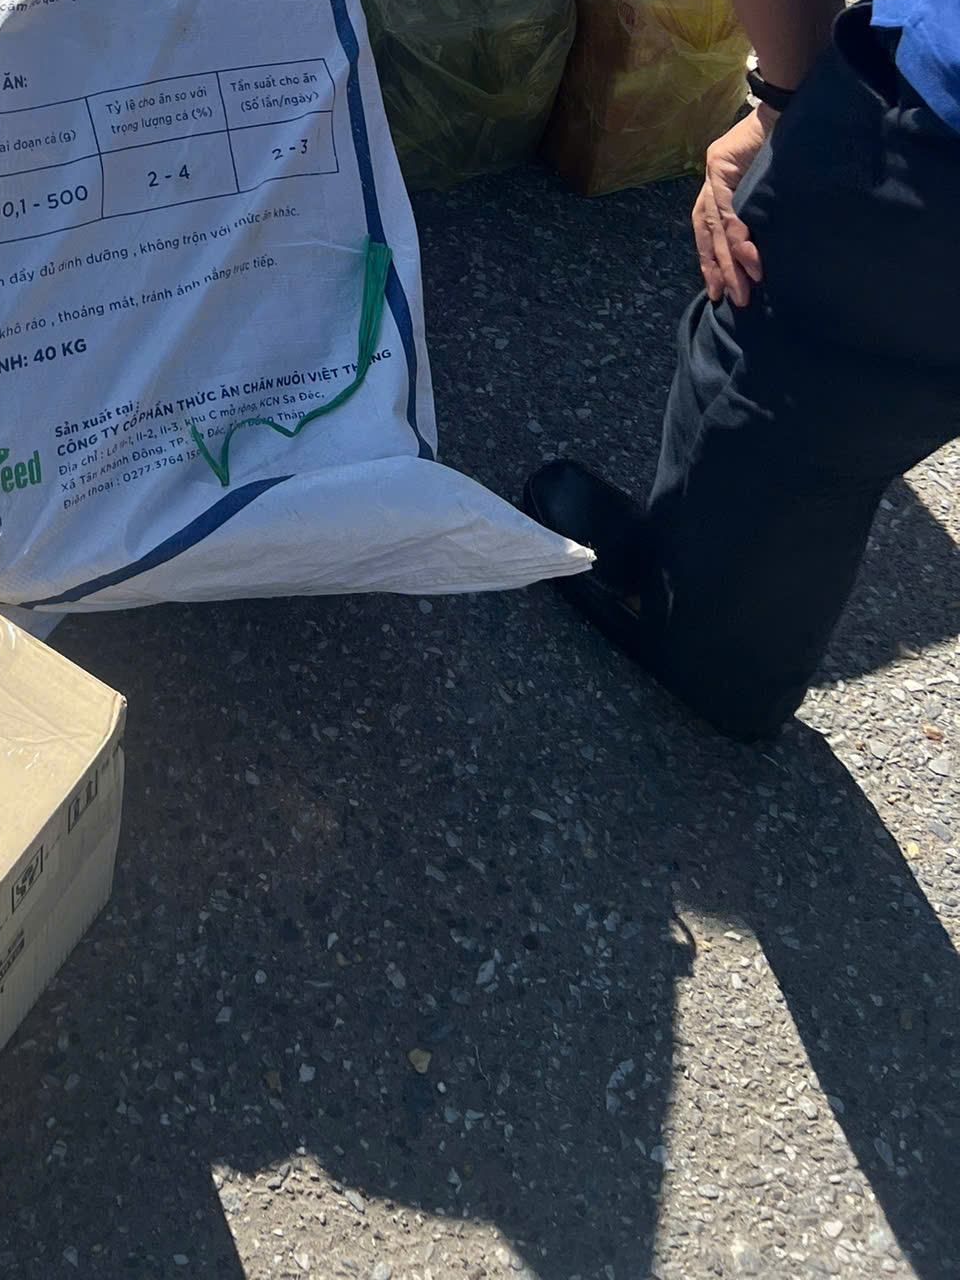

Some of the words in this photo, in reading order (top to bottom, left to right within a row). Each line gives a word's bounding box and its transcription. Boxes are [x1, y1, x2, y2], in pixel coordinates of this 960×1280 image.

[2, 72, 28, 90] ĂN:
[13, 137, 42, 153] đoạn
[44, 132, 57, 145] cá
[59, 129, 77, 144] (g)
[47, 184, 89, 210] 500
[33, 345, 57, 363] 40
[62, 338, 88, 357] KG
[57, 434, 99, 458] CÔNG
[101, 423, 120, 439] TY
[176, 389, 218, 411] THỨC
[220, 380, 240, 399] ĂN
[243, 377, 275, 395] CHĂN
[275, 372, 306, 388] NUÔI
[308, 366, 339, 383] VIỆT
